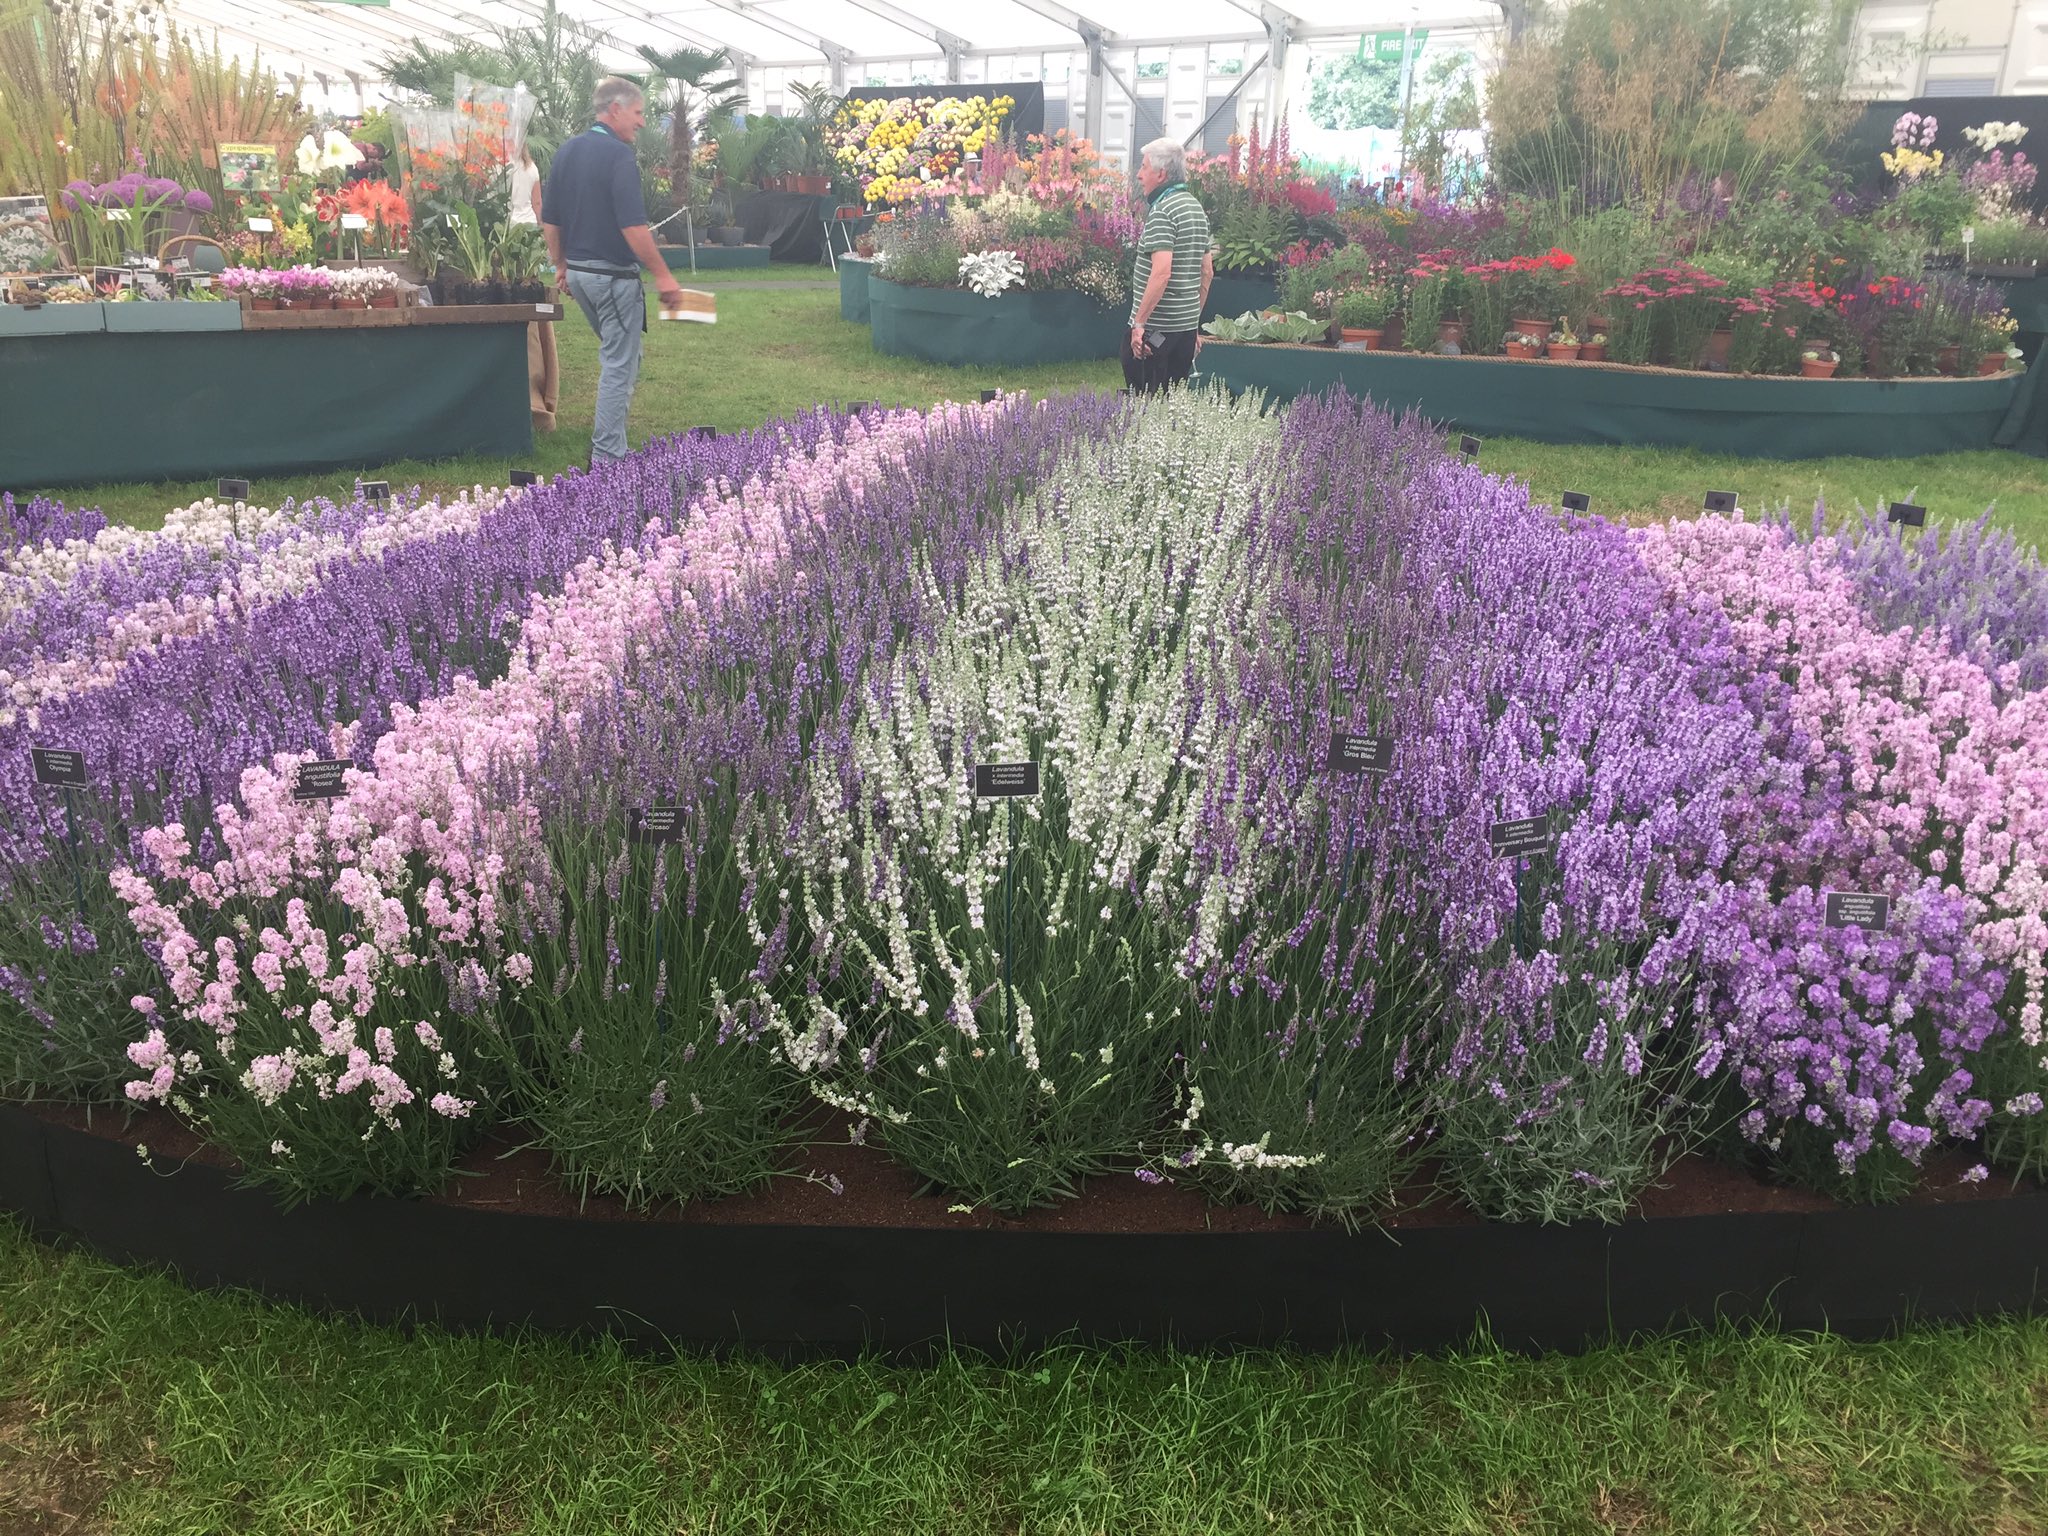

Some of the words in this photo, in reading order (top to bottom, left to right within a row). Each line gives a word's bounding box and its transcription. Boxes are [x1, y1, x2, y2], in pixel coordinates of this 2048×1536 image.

[1381, 40, 1402, 51] FIRE
[1346, 736, 1378, 746] Lavandula
[302, 764, 340, 772] LAVANDULA
[304, 772, 340, 780] angustifolia
[1505, 822, 1534, 832] Lavandula
